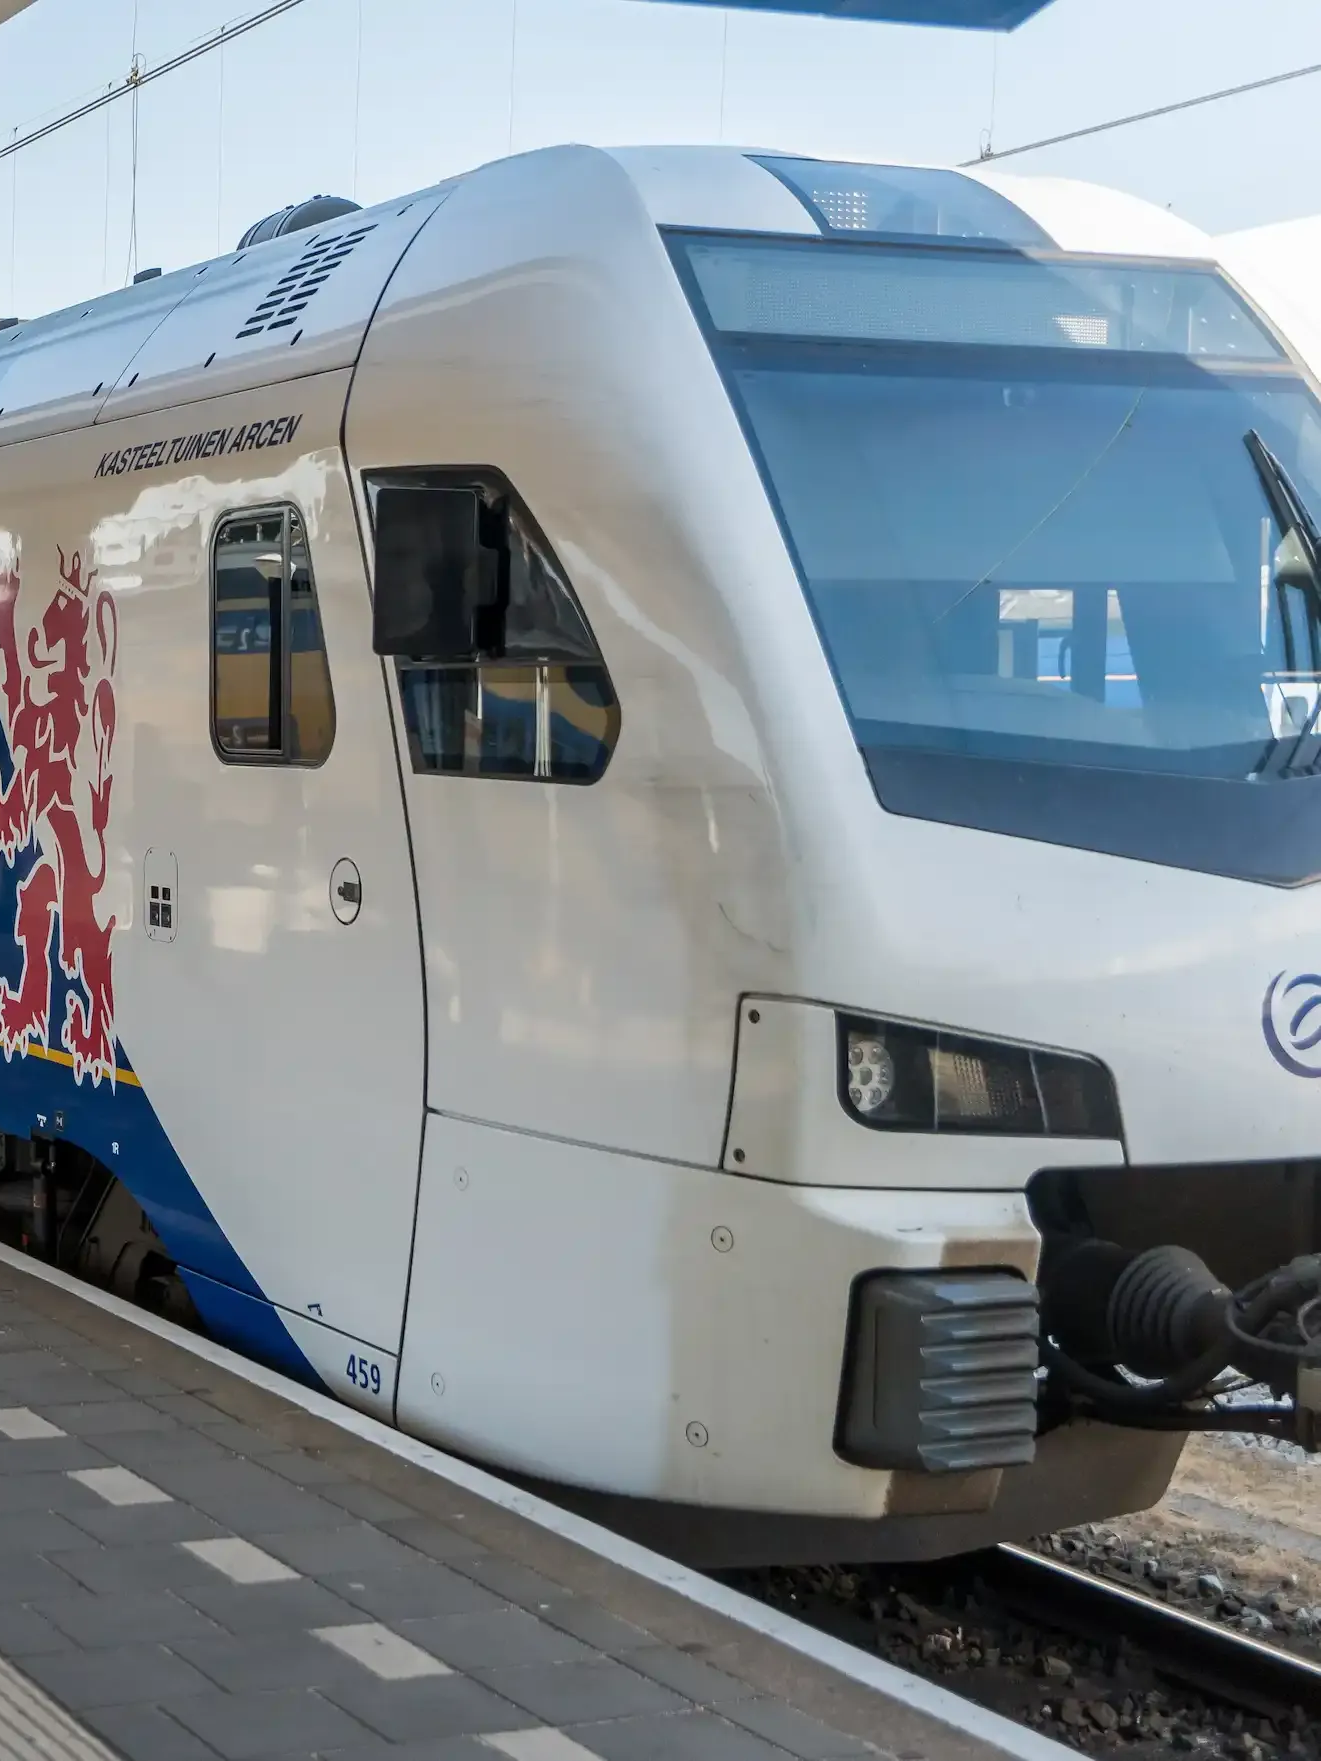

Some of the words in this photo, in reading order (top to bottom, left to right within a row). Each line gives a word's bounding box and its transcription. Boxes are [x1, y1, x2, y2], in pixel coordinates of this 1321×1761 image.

[94, 427, 233, 479] KASTEELTUINEN
[227, 413, 303, 454] ARCEN
[345, 1353, 381, 1395] 459
